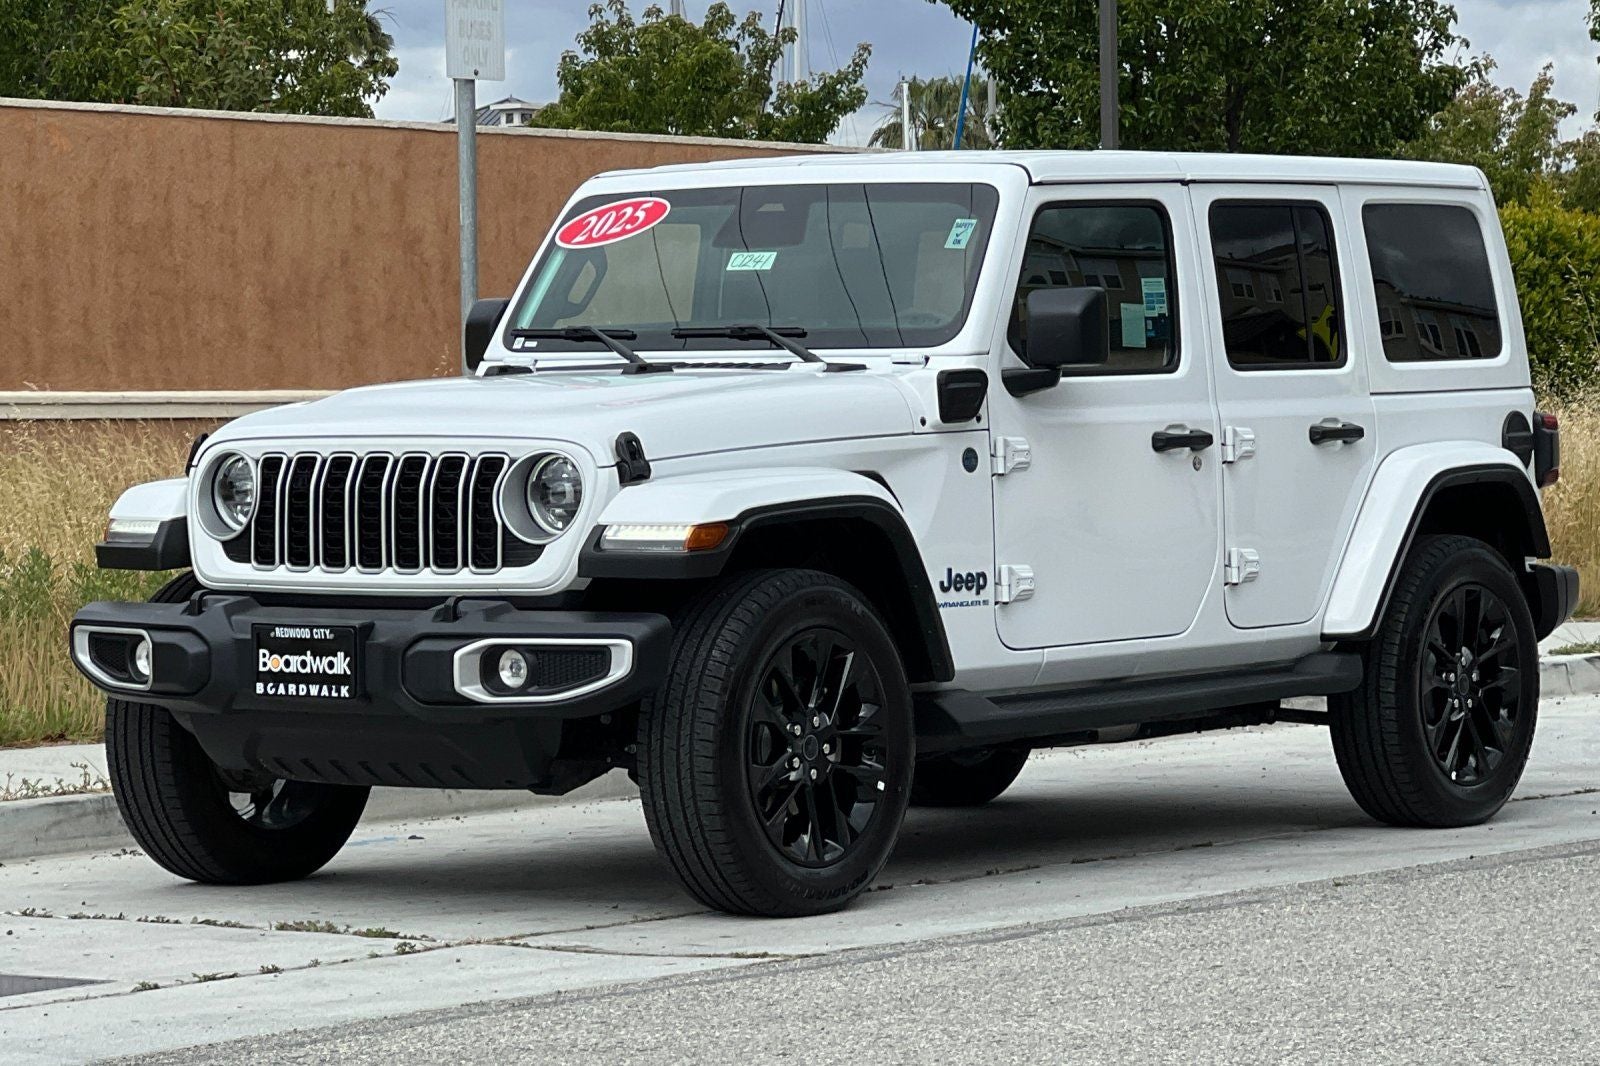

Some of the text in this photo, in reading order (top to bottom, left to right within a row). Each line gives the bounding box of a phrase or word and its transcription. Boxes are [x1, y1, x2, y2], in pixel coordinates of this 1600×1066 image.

[463, 46, 488, 66] ONLY
[571, 202, 654, 243] 2025
[939, 567, 987, 595] Jeep
[938, 600, 981, 609] WRANGLER
[275, 627, 331, 640] REDWOOD CITY
[259, 648, 351, 675] Boardwalk
[255, 682, 350, 698] BOARDWALK
